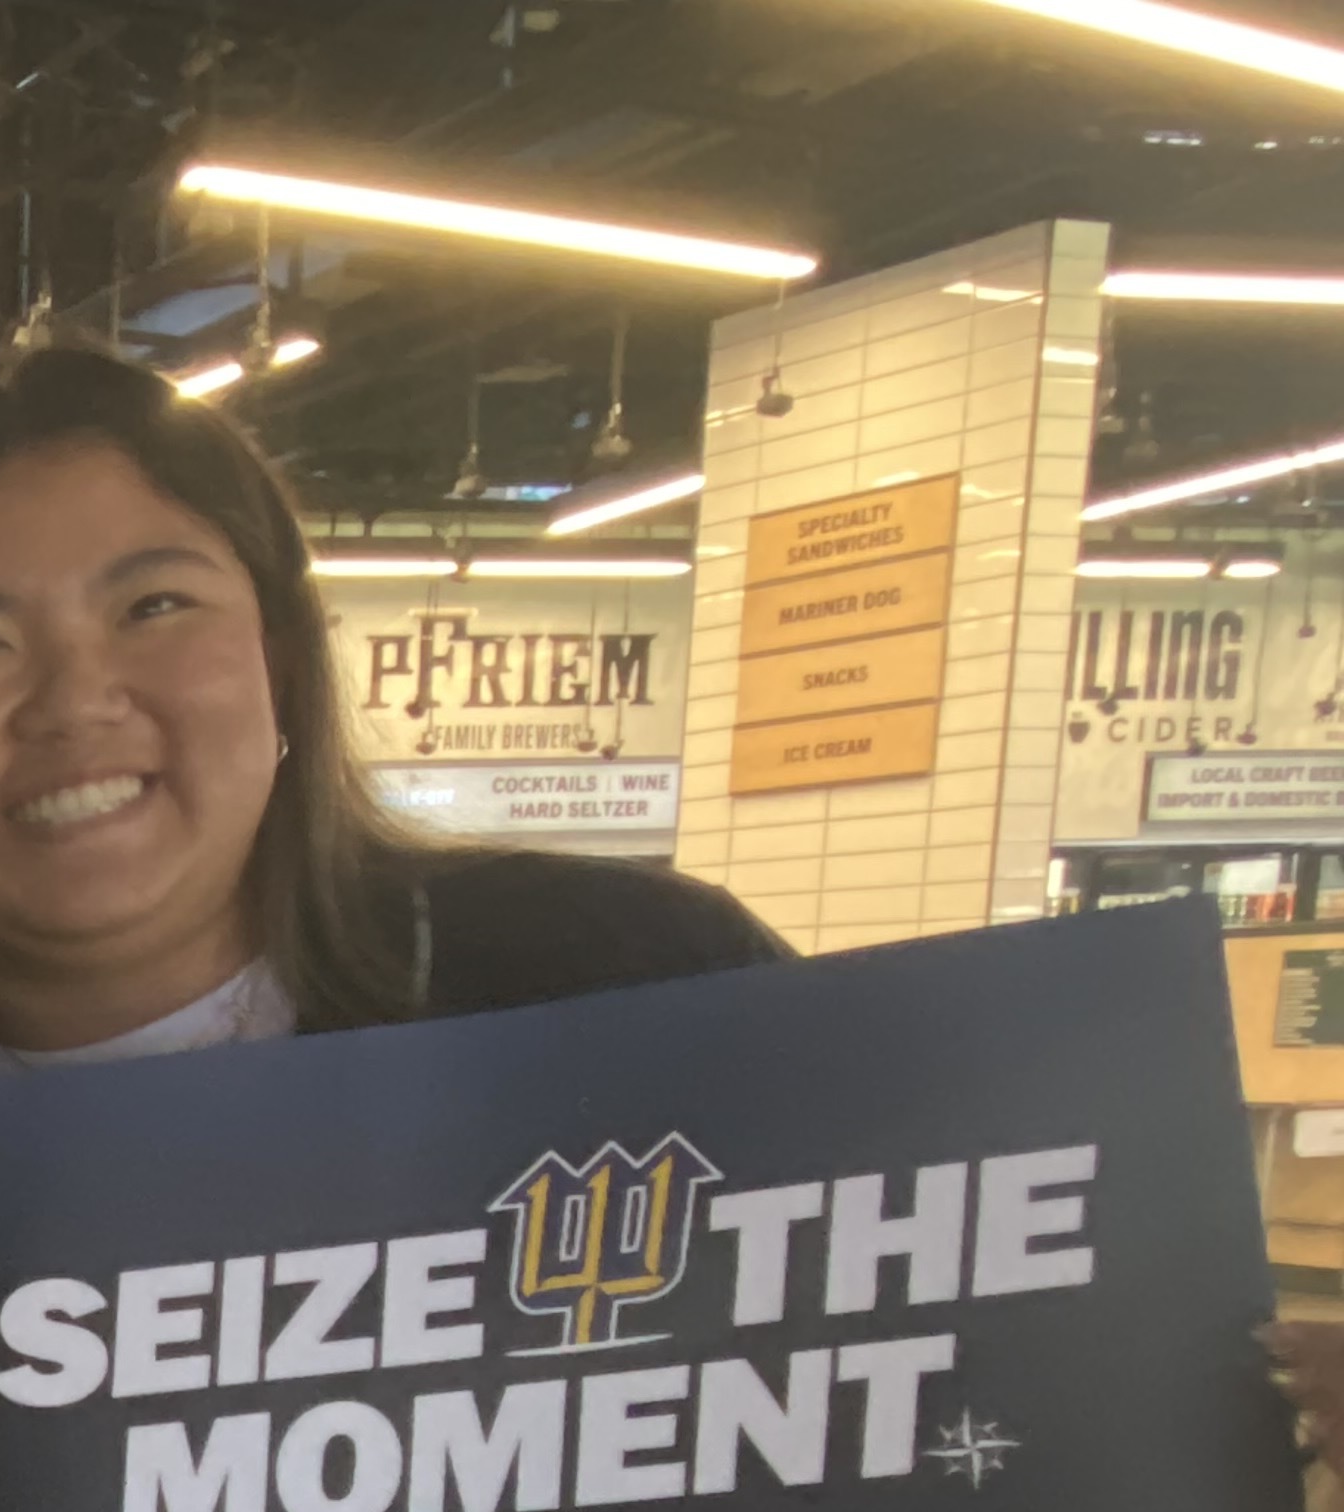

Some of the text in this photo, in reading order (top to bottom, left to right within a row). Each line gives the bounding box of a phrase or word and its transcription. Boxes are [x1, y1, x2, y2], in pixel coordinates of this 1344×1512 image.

[798, 502, 894, 539] SPECIALTY
[787, 526, 905, 566] SANDWICHES
[778, 587, 902, 625] MARINER DOG
[1063, 610, 1243, 700] ILLING
[802, 664, 869, 691] SNACKS
[433, 723, 581, 751] FAMILY BREWERS
[1108, 716, 1233, 743] CIDER
[782, 737, 873, 764] ICE CREAM
[492, 773, 670, 795] COCKTAILS WINE
[1190, 767, 1245, 783] LOCAL
[1249, 766, 1305, 782] CRAFT
[510, 801, 648, 820] HARD SELTZER
[1157, 792, 1225, 808] IMPORT
[1244, 790, 1332, 807] DOMESTIC
[710, 1144, 1097, 1327] THE
